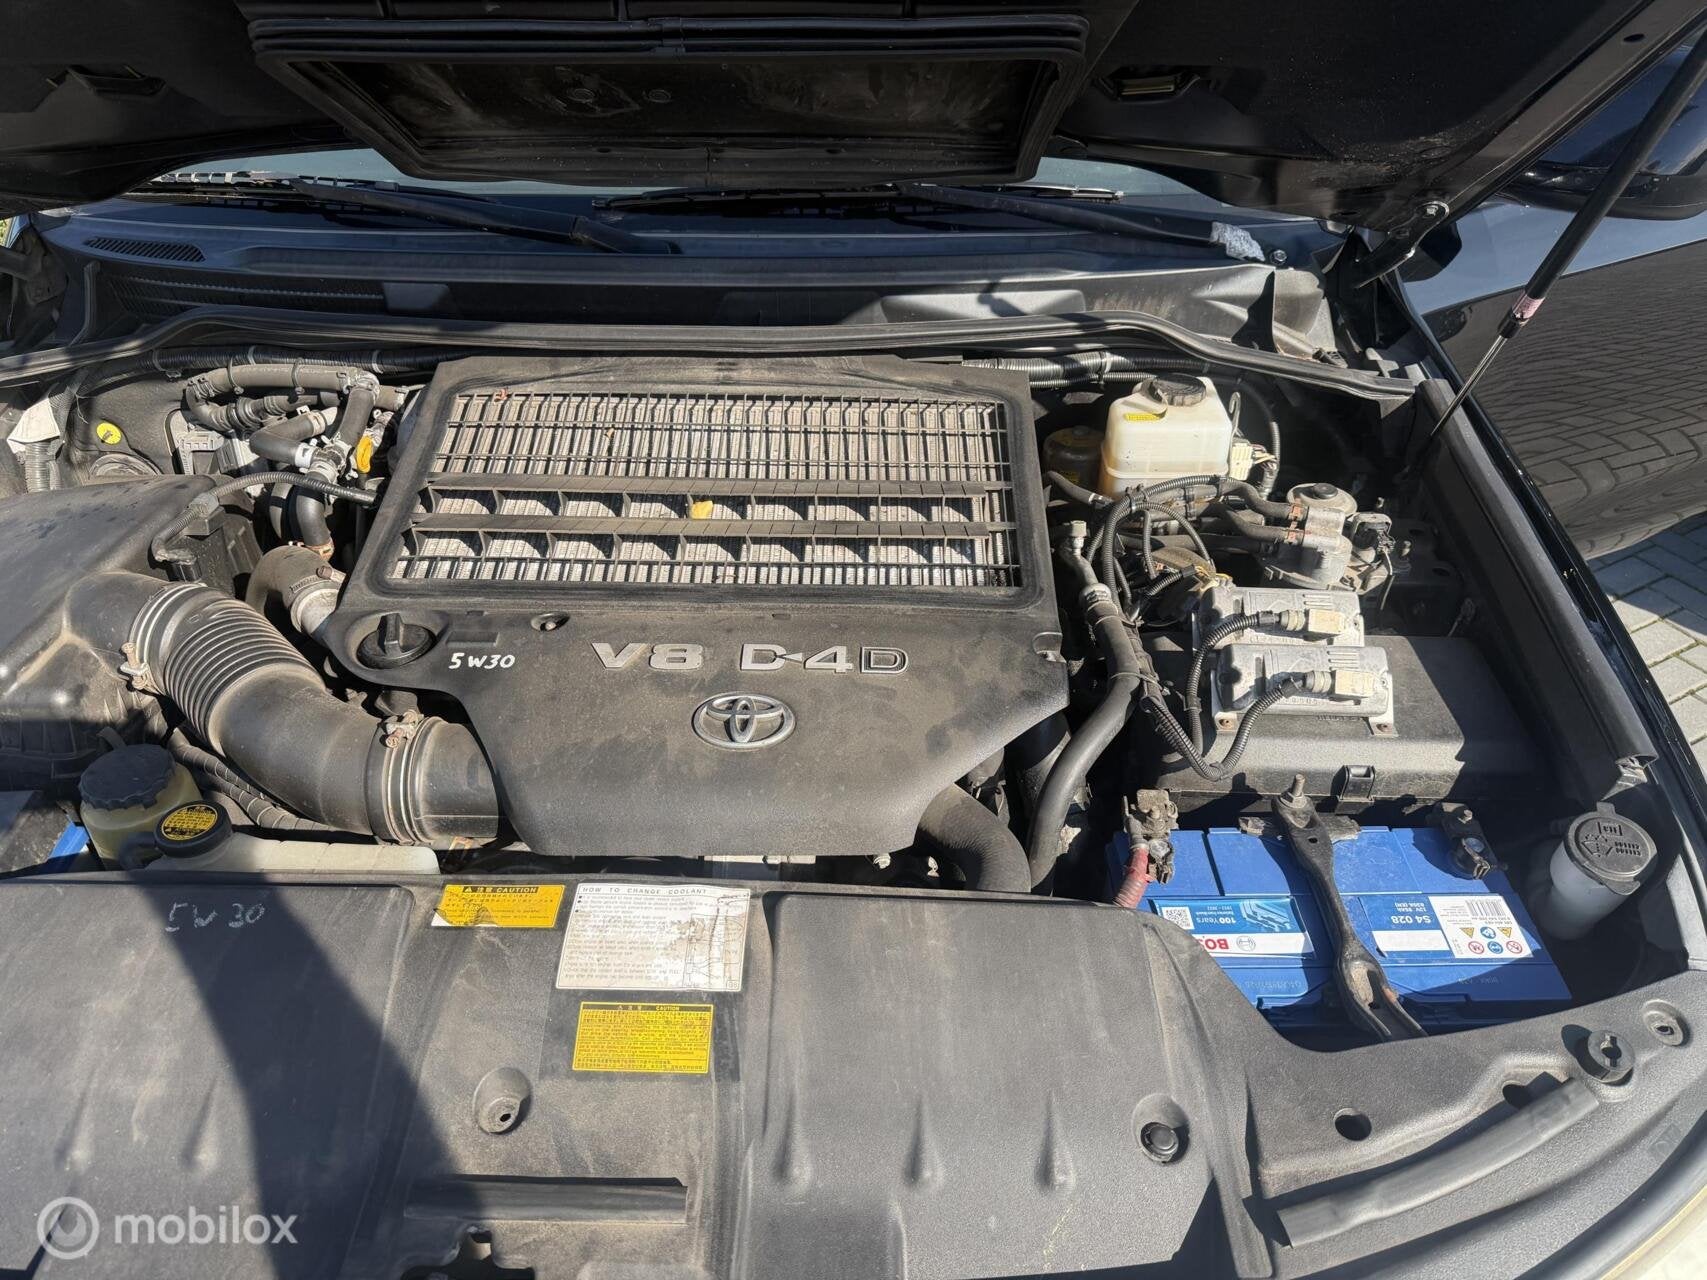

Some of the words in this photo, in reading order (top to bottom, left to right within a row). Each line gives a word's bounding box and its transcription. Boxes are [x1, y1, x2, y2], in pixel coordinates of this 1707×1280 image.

[592, 642, 702, 671] V8
[1391, 915, 1413, 924] 028
[1415, 915, 1431, 924] S4
[1199, 938, 1229, 950] BO
